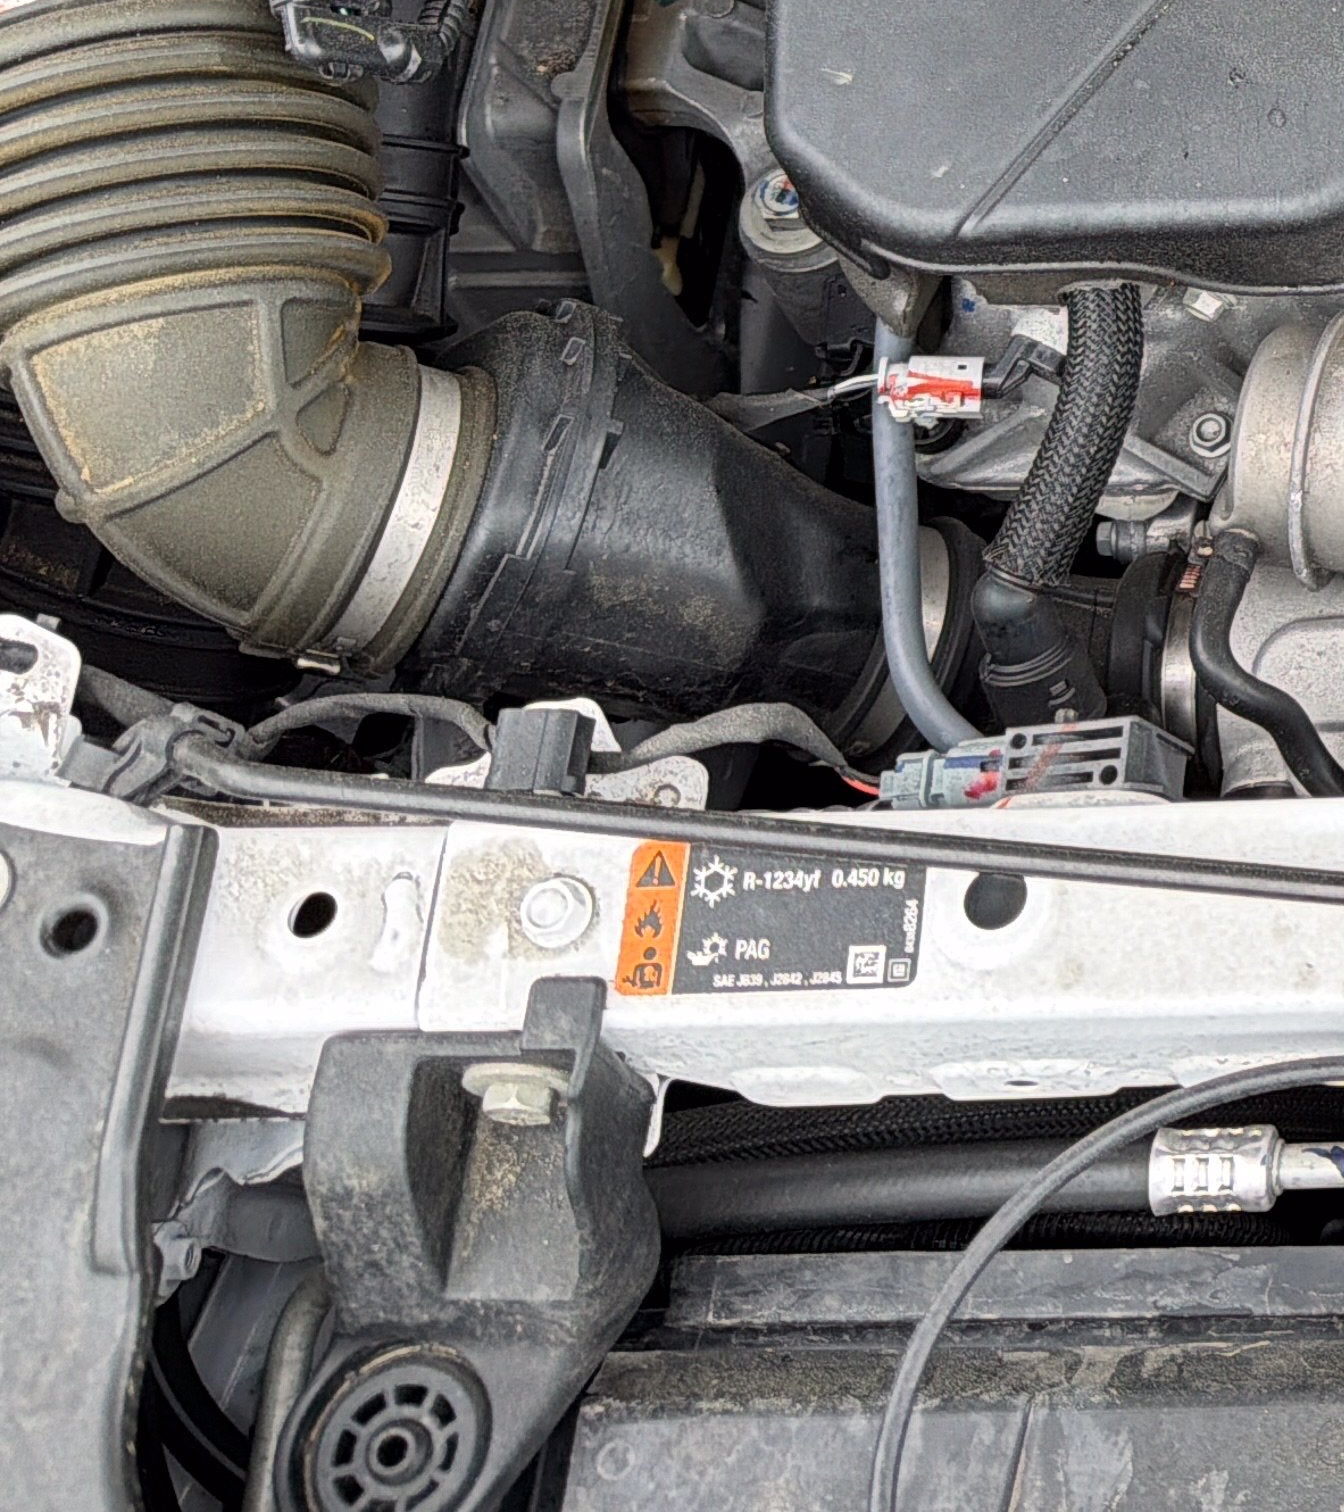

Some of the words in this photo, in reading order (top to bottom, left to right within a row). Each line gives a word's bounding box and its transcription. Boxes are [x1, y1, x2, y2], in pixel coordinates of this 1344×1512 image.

[743, 869, 822, 893] R-1234yf
[831, 869, 880, 889] 0.450
[882, 867, 906, 890] kg
[734, 939, 771, 961] PAG
[713, 973, 735, 988] SAE
